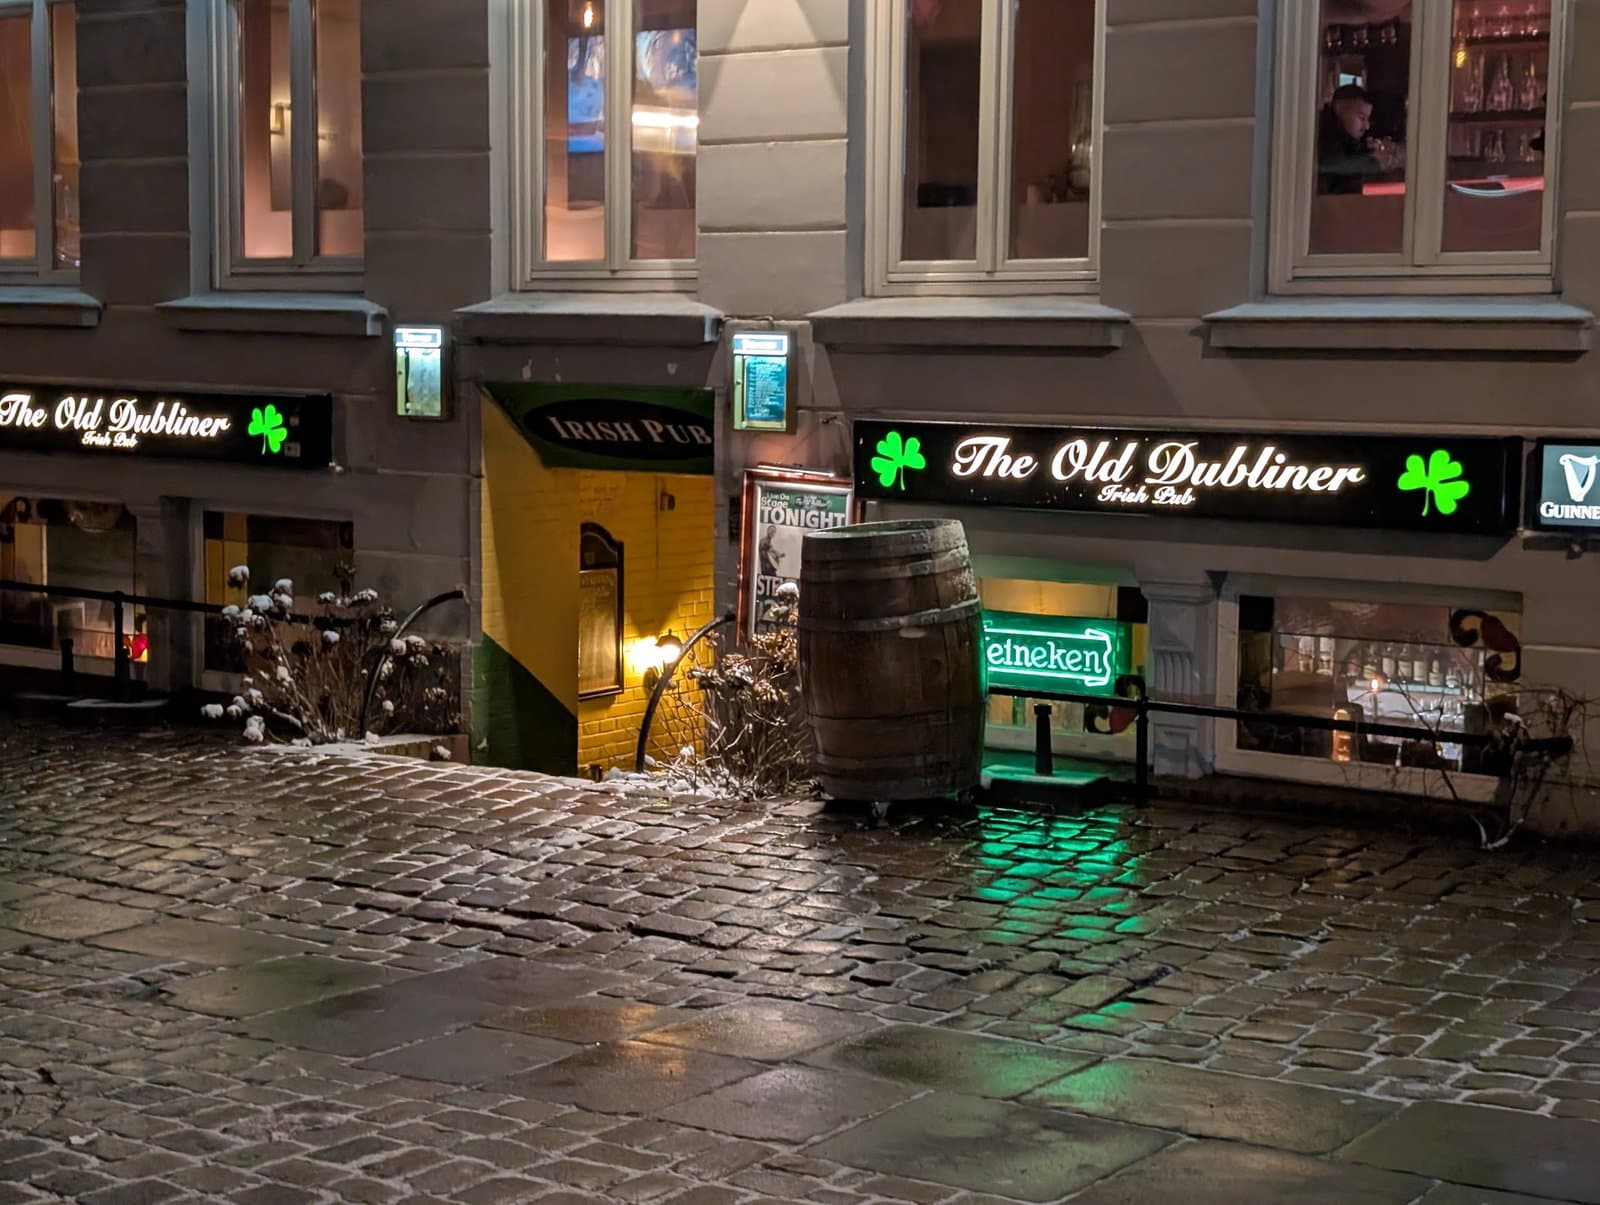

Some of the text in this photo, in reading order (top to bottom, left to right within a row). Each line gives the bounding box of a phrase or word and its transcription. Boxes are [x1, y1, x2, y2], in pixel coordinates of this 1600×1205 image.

[0, 394, 230, 437] The Old Dubliner
[82, 431, 138, 448] Irish Pub
[547, 416, 712, 444] IRISH PUB
[952, 436, 1365, 492] The Old Dubliner
[761, 496, 789, 509] Stage
[1097, 484, 1196, 505] Irish Pub
[761, 507, 846, 529] TONIGHT
[985, 636, 1102, 673] eineken
